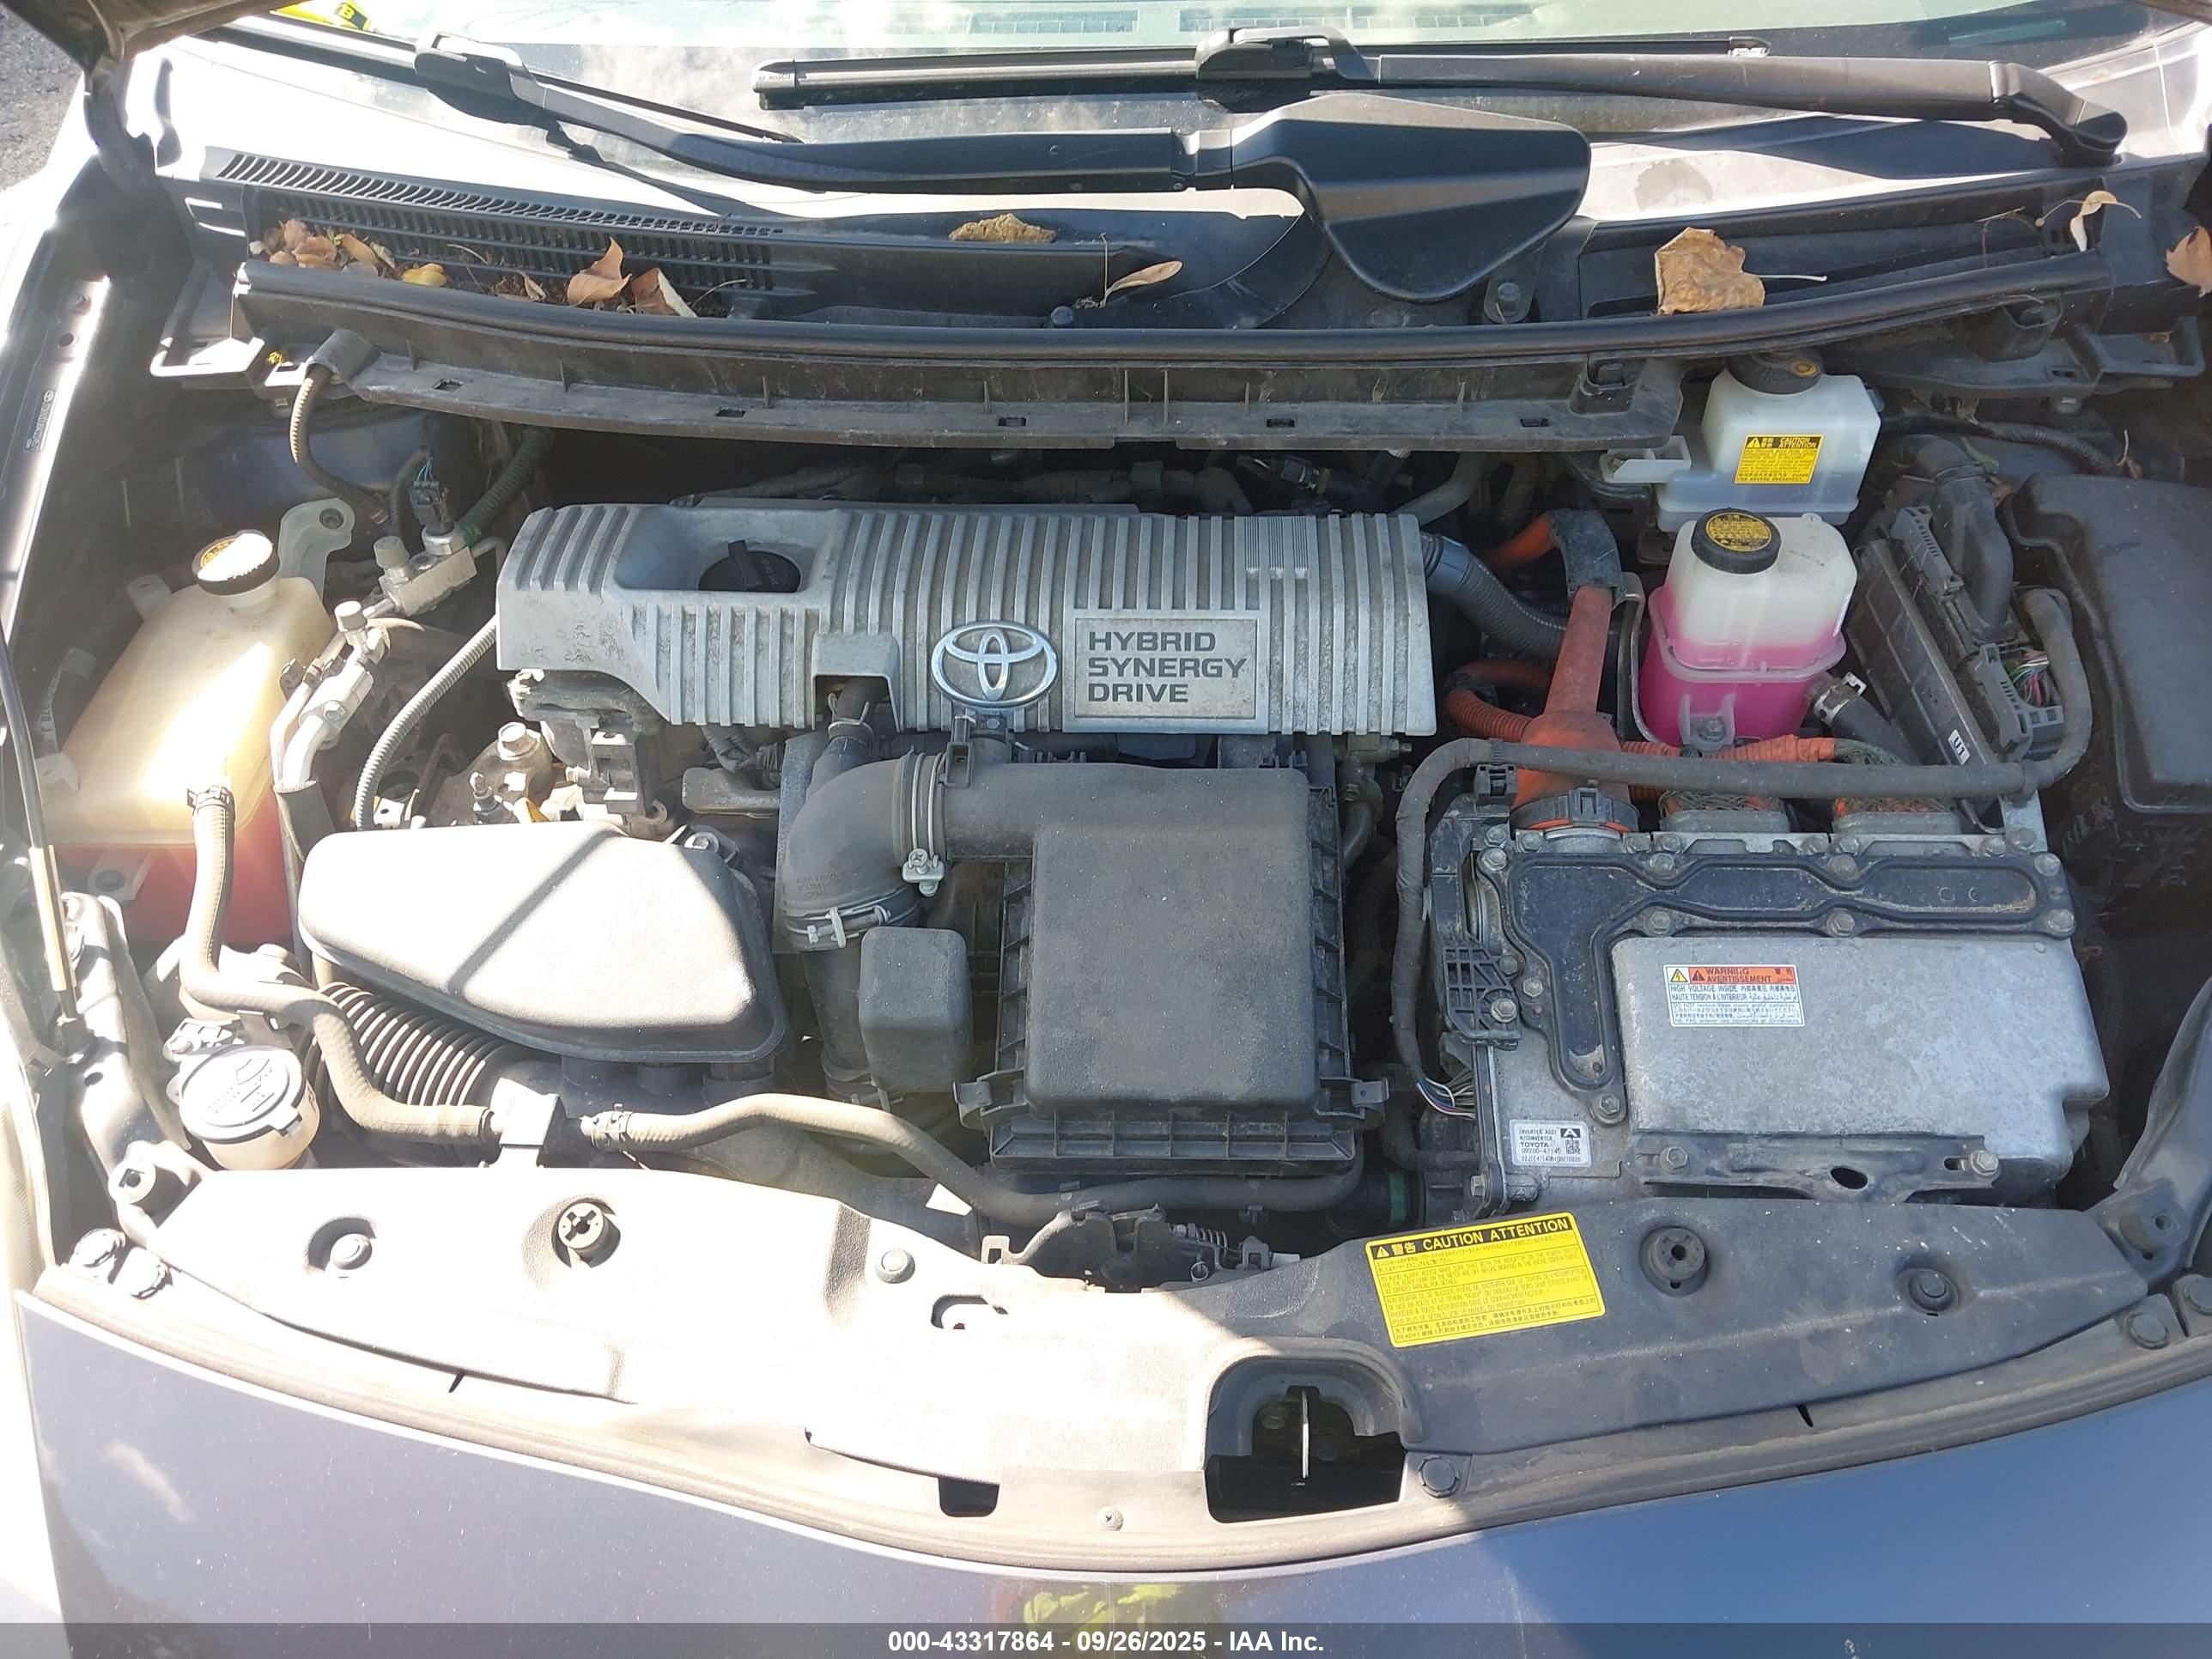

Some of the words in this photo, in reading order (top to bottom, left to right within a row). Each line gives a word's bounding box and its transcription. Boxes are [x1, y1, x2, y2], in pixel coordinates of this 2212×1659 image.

[1089, 631, 1216, 652] HYBRID
[1088, 657, 1248, 678] SYNERGY
[1088, 683, 1188, 702] DRIVE
[1422, 1231, 1484, 1251] CAUTION
[1490, 1218, 1569, 1241] ATTENTION
[1391, 1242, 1416, 1255] 警告
